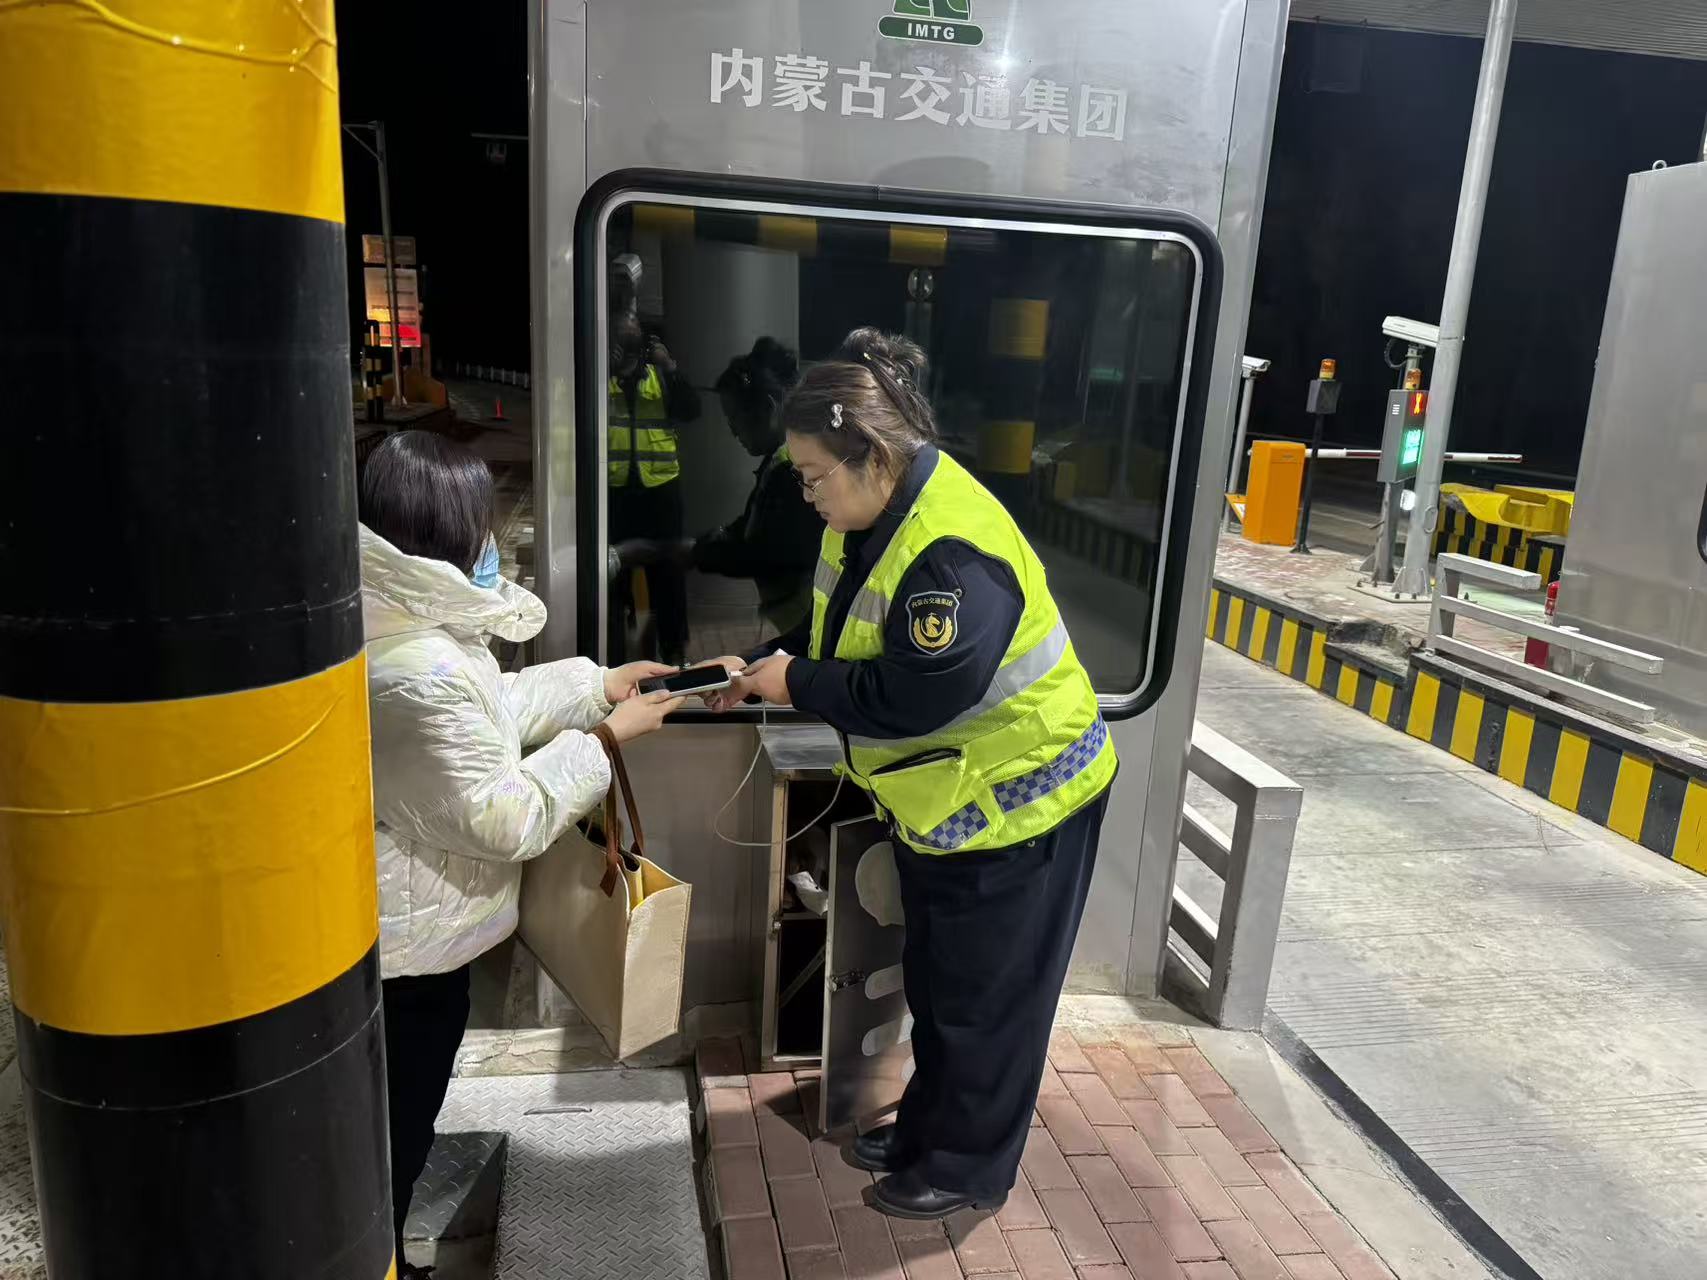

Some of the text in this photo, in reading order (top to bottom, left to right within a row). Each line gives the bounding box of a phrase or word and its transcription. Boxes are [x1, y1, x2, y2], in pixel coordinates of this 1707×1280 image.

[907, 23, 955, 40] IMTG
[710, 48, 1128, 142] 内蒙古交通集团
